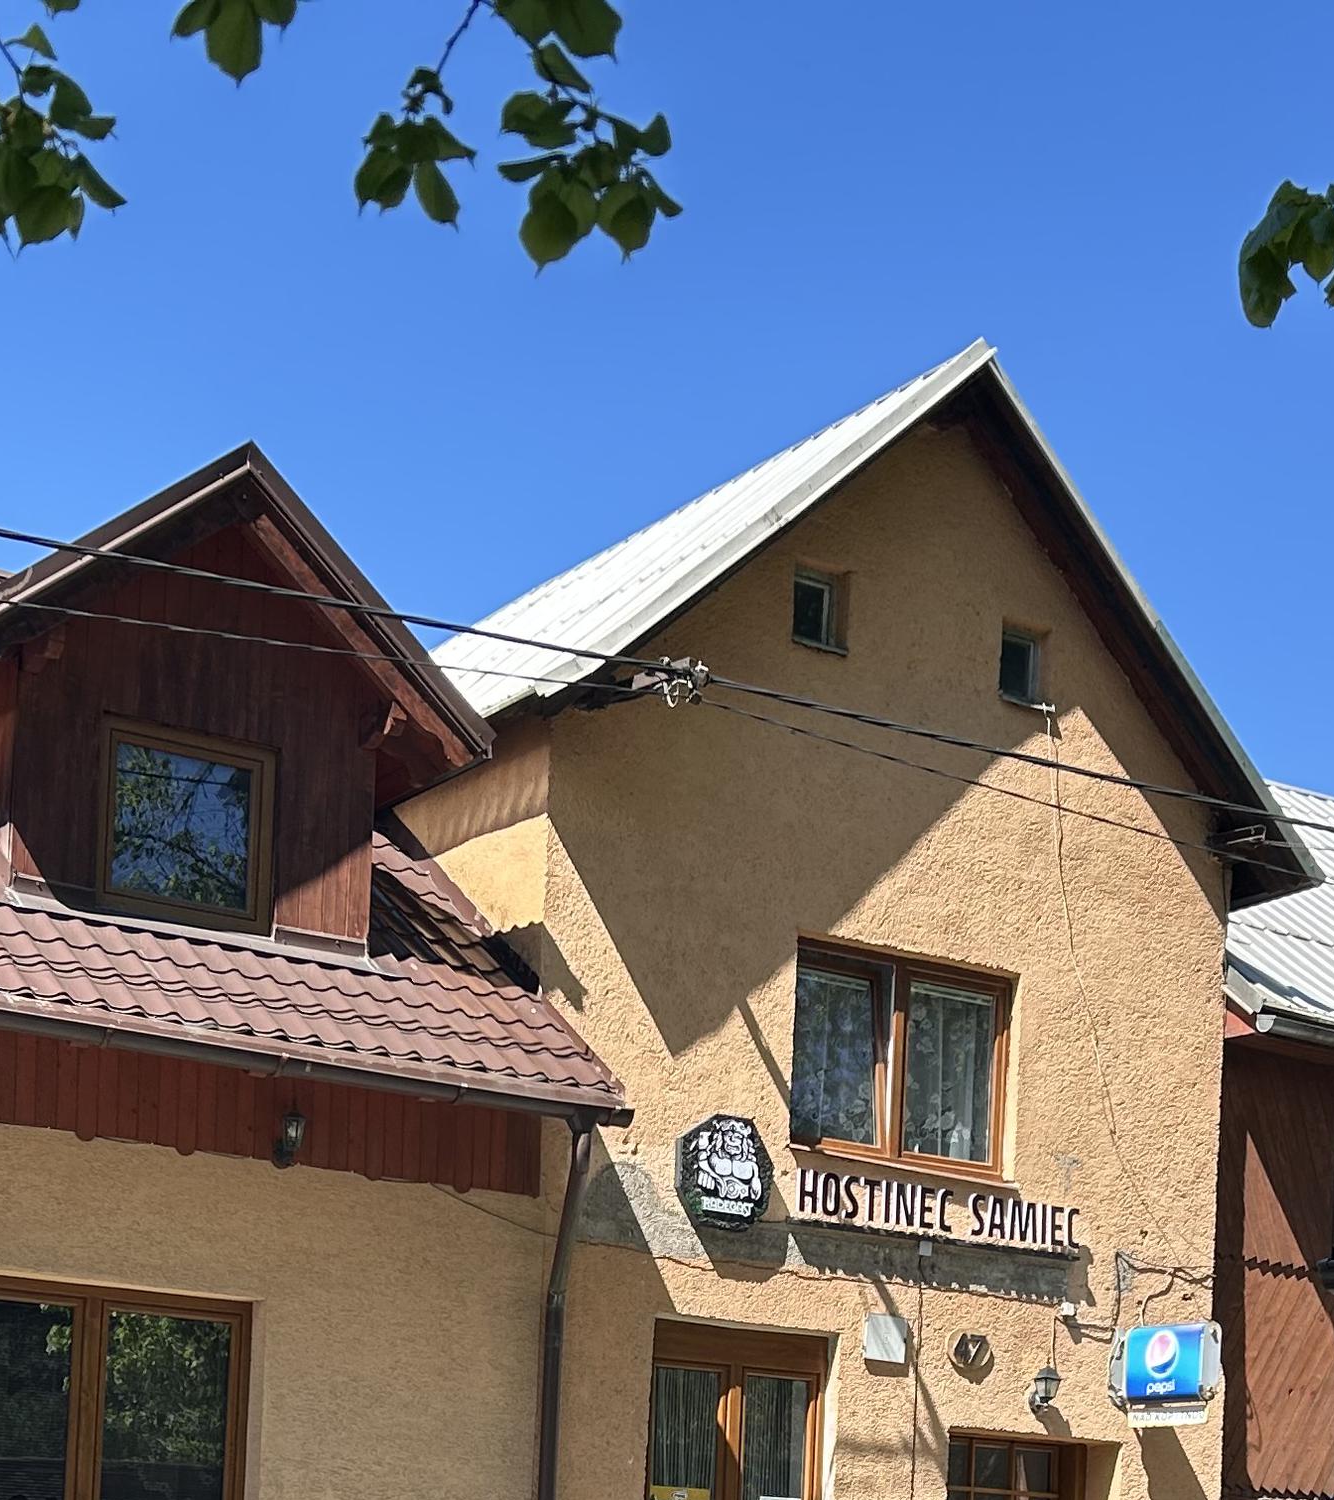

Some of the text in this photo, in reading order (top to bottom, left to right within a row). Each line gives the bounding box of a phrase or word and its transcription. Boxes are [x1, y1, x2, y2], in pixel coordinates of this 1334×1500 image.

[701, 1196, 754, 1217] RADEGAST
[796, 1167, 1080, 1250] HOSTINEC SAMIEC
[1146, 1378, 1176, 1396] pepsi
